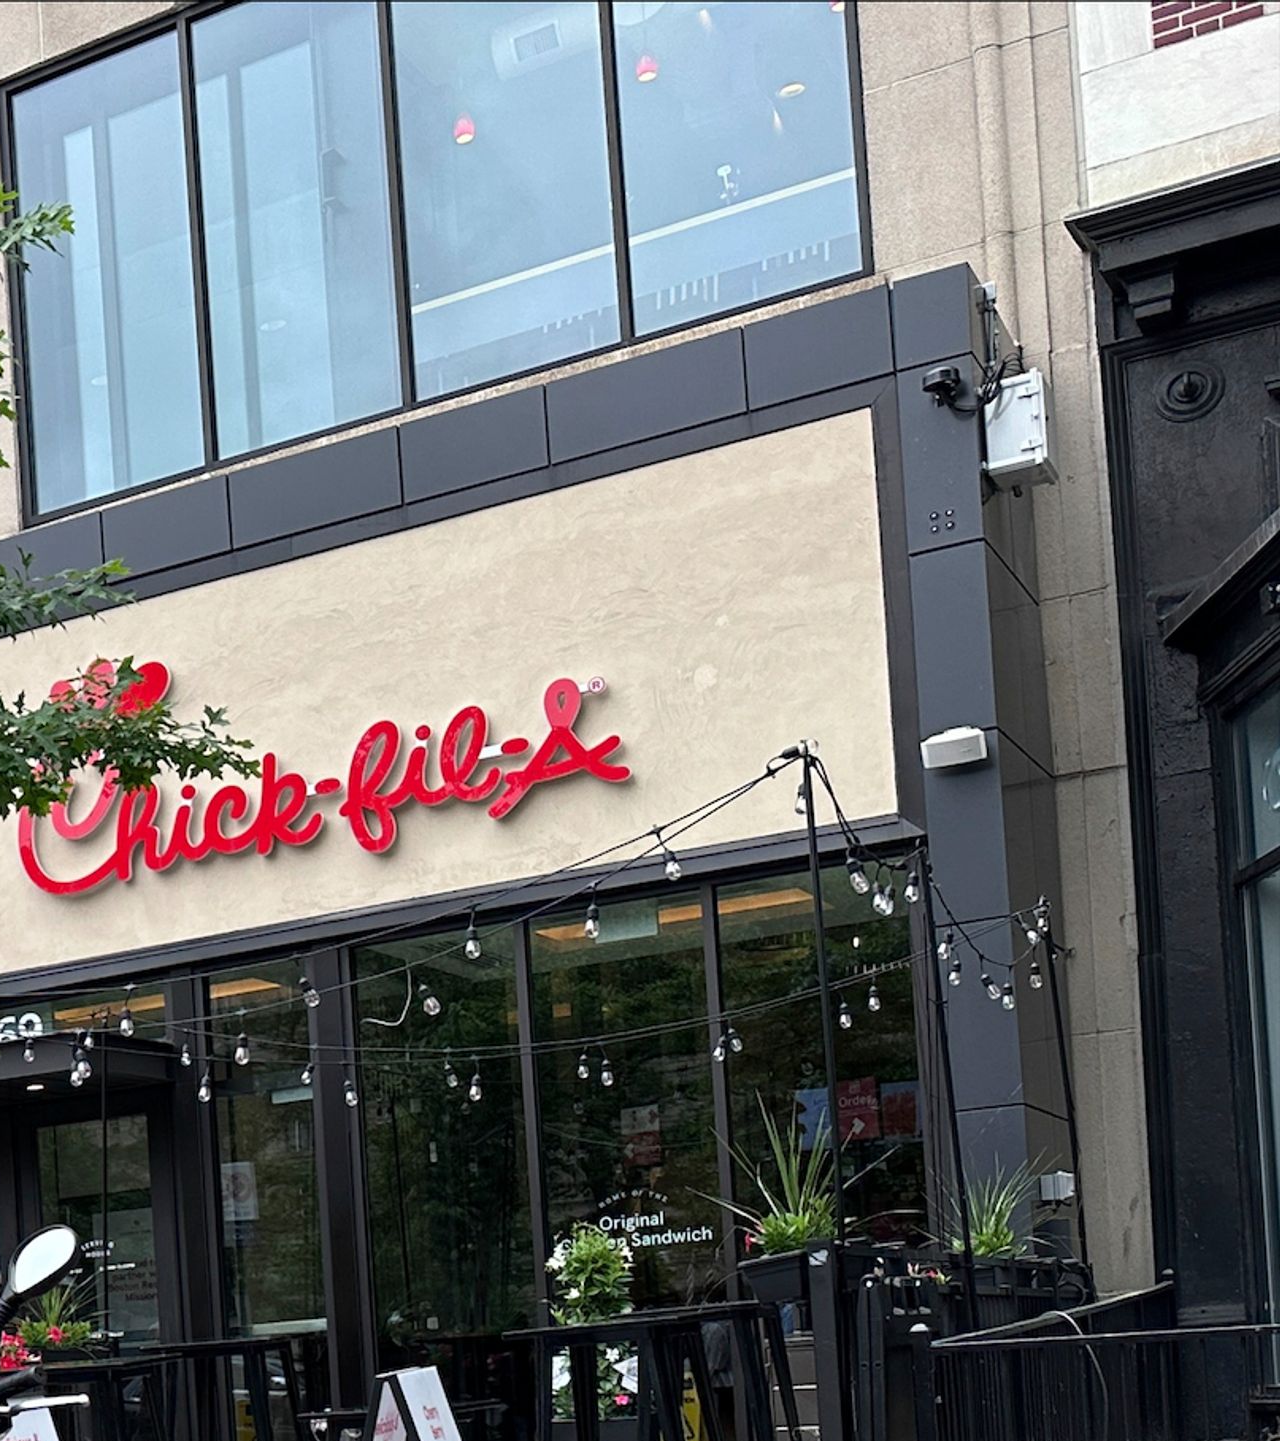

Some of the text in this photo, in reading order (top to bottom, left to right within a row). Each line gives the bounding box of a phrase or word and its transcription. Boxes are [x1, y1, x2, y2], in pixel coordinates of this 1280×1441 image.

[18, 662, 632, 894] Chick-fil-A
[599, 1211, 665, 1231] Original
[631, 1226, 713, 1247] Sandwich
